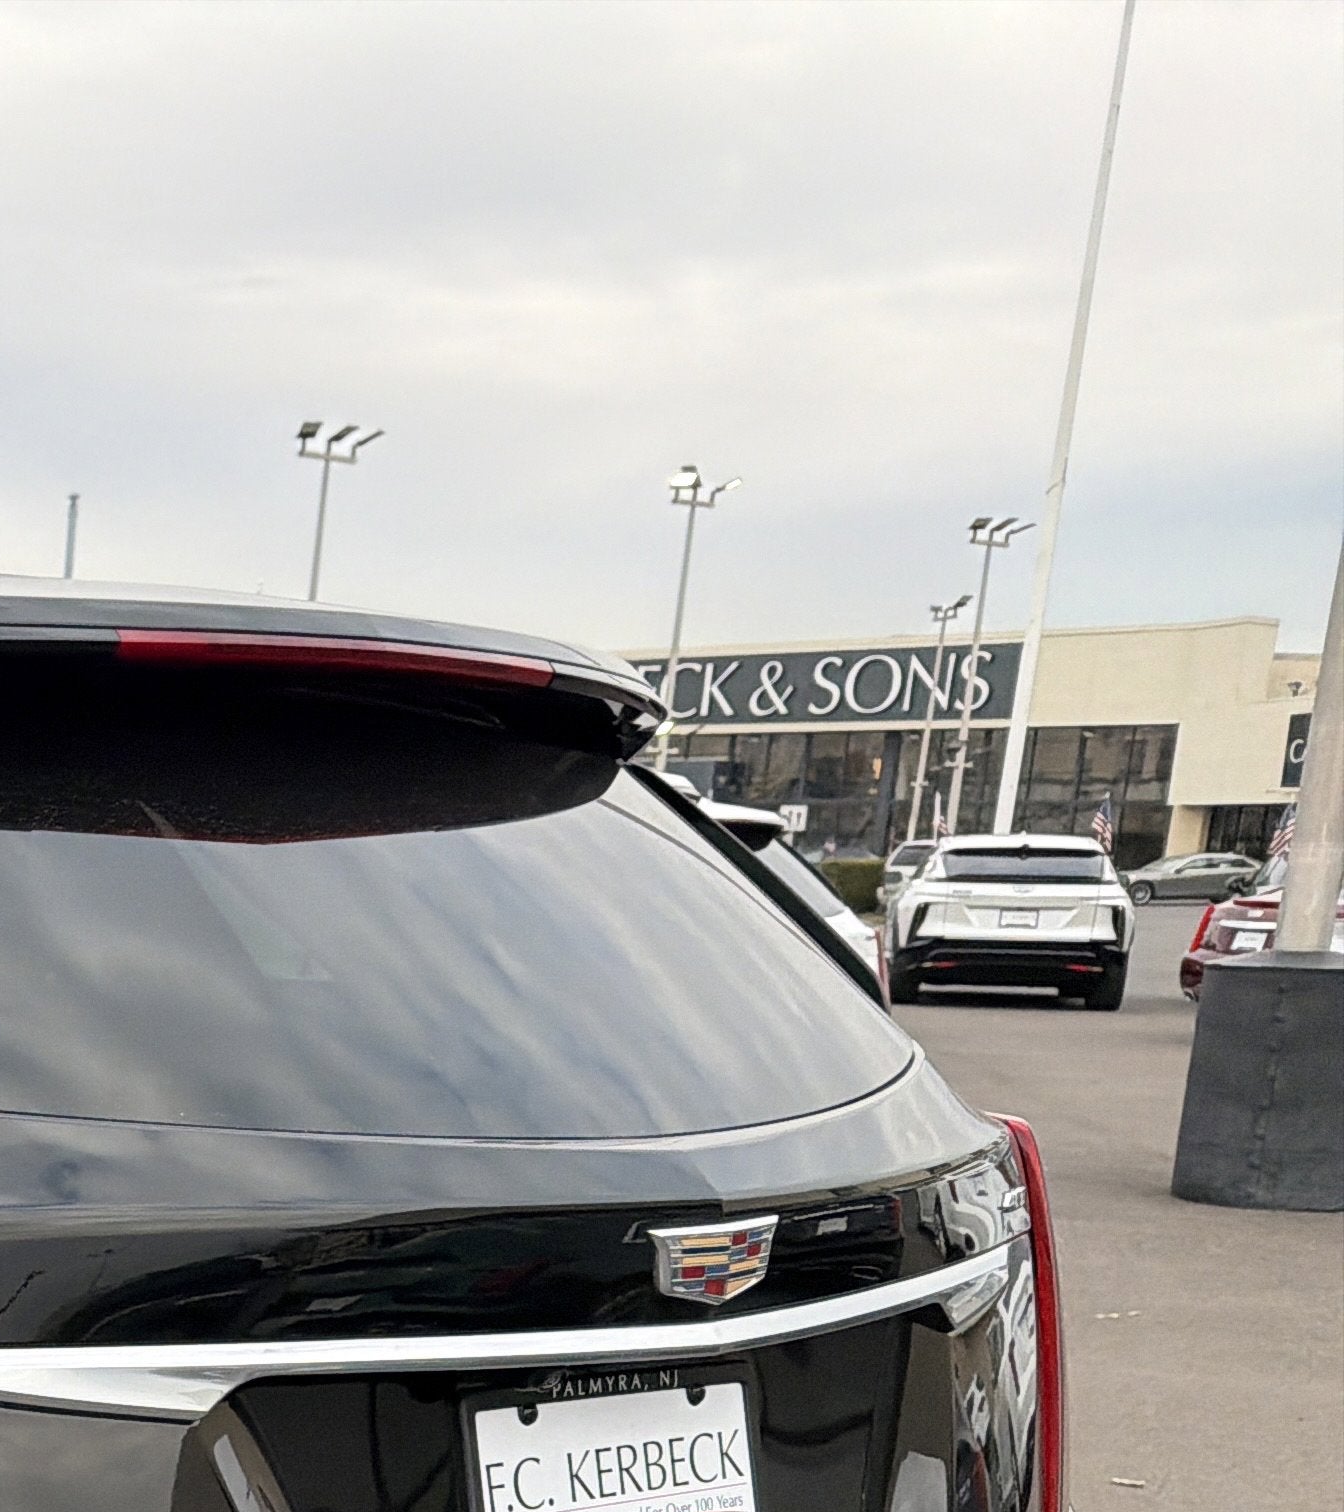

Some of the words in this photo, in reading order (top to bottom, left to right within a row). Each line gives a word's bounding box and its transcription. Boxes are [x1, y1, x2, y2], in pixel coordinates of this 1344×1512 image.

[748, 660, 794, 717] &
[808, 650, 993, 716] SONS
[551, 1374, 649, 1398] PALMYRA,
[659, 1370, 679, 1388] NJ
[567, 1428, 745, 1503] KERBECK
[694, 1497, 714, 1512] 100
[715, 1493, 744, 1509] Years
